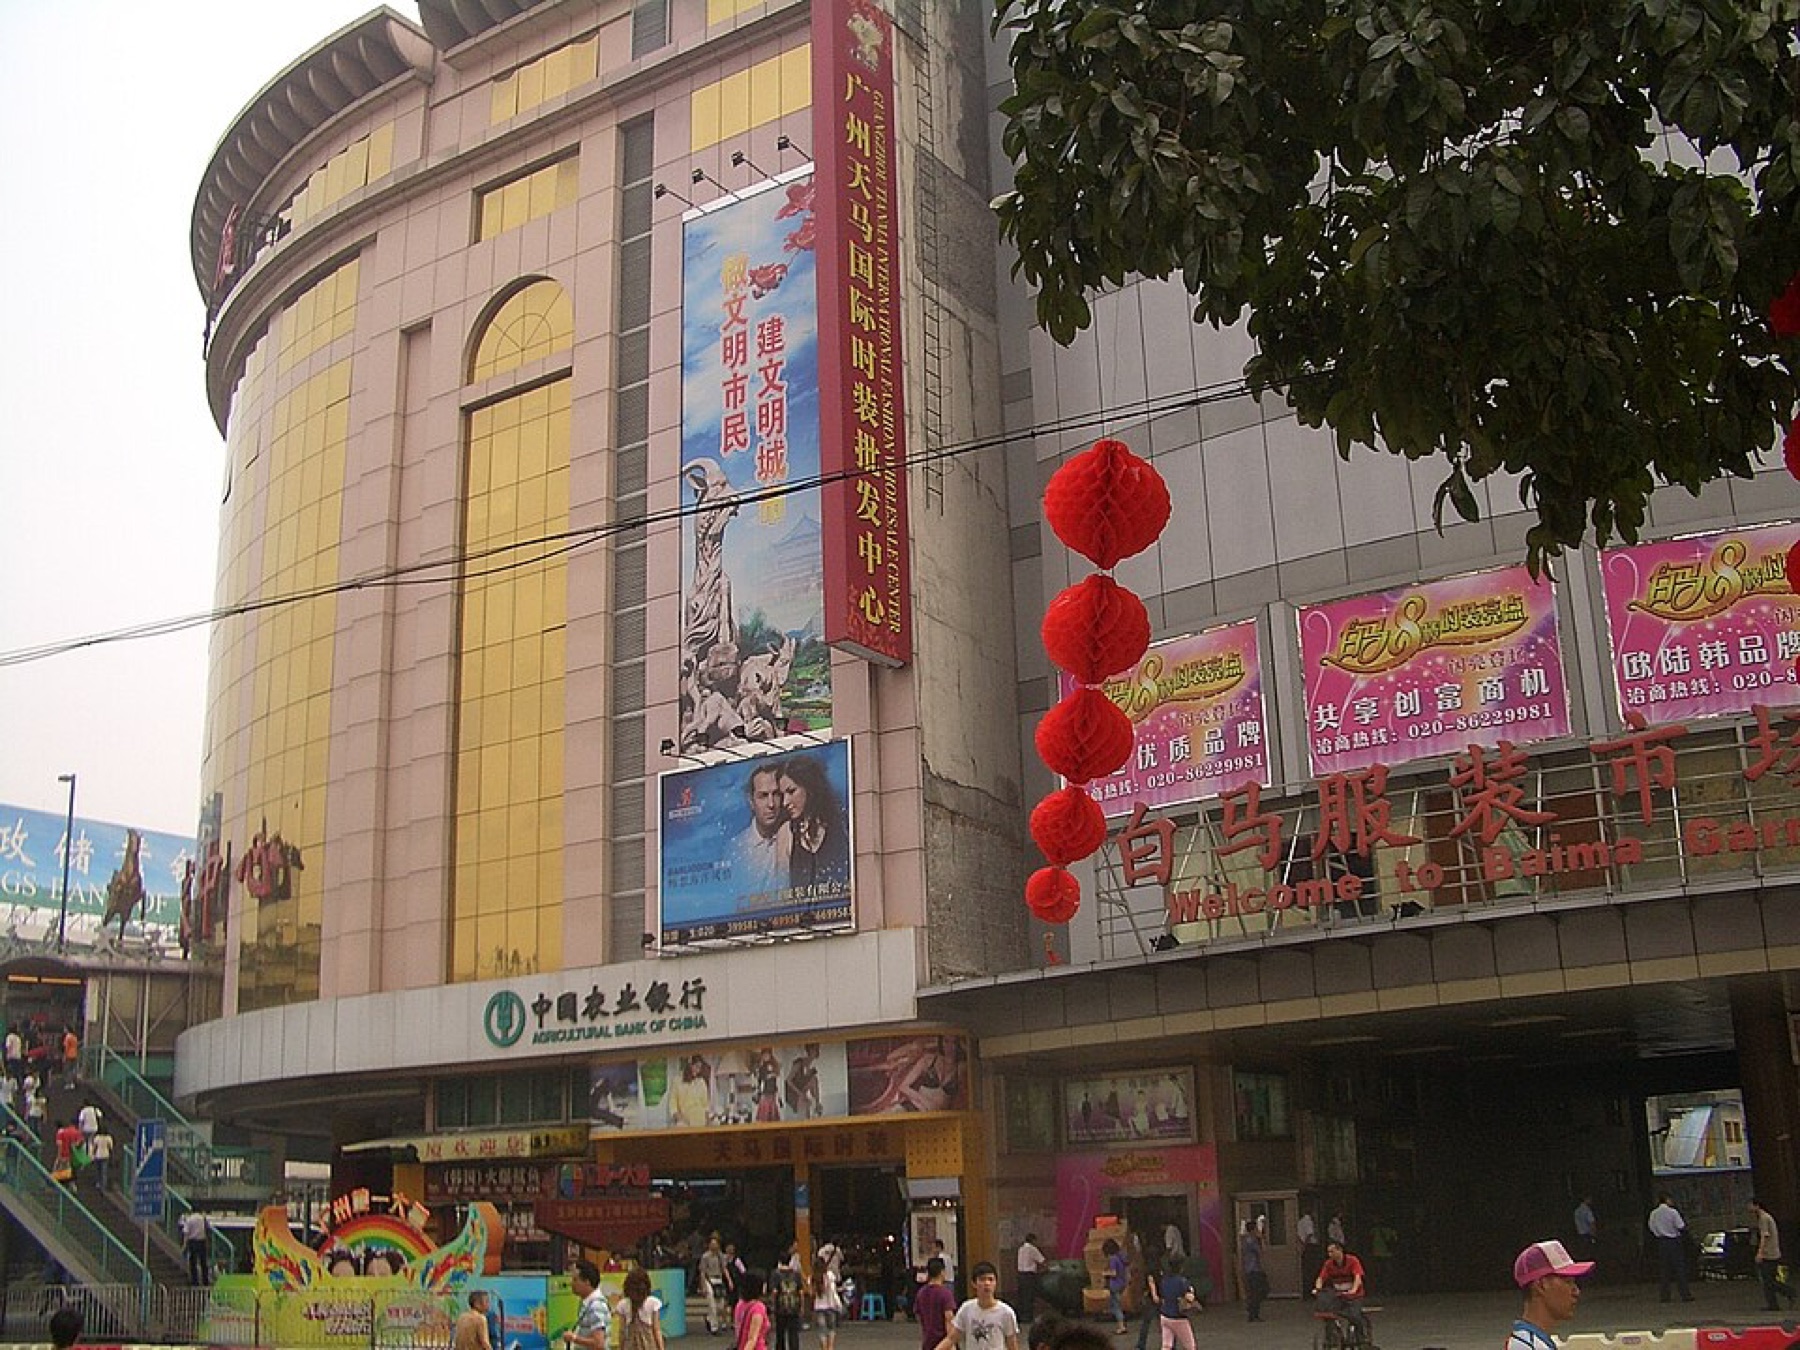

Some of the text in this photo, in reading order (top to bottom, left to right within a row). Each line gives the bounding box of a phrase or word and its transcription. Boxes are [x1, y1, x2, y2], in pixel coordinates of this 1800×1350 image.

[873, 89, 886, 183] GUANGZHOU
[875, 186, 888, 244] TIANMA
[877, 247, 892, 374] INTERNATIONAL
[845, 72, 884, 625] 广州天马国际时装批发中心
[881, 378, 894, 450] FASHION
[887, 563, 901, 632] CENTER
[1621, 630, 1800, 681] 欧陆韩品牌
[1314, 668, 1550, 731] 共享创富商机
[1408, 702, 1553, 739] 020-86229981
[1146, 752, 1264, 790] 020-86229981
[1169, 873, 1365, 924] Welcome
[1394, 860, 1444, 893] to
[1482, 833, 1643, 882] Baima
[531, 977, 708, 1029] 中国农业银行
[532, 1015, 708, 1045] AGRICULTURAL BANK OF CHINA
